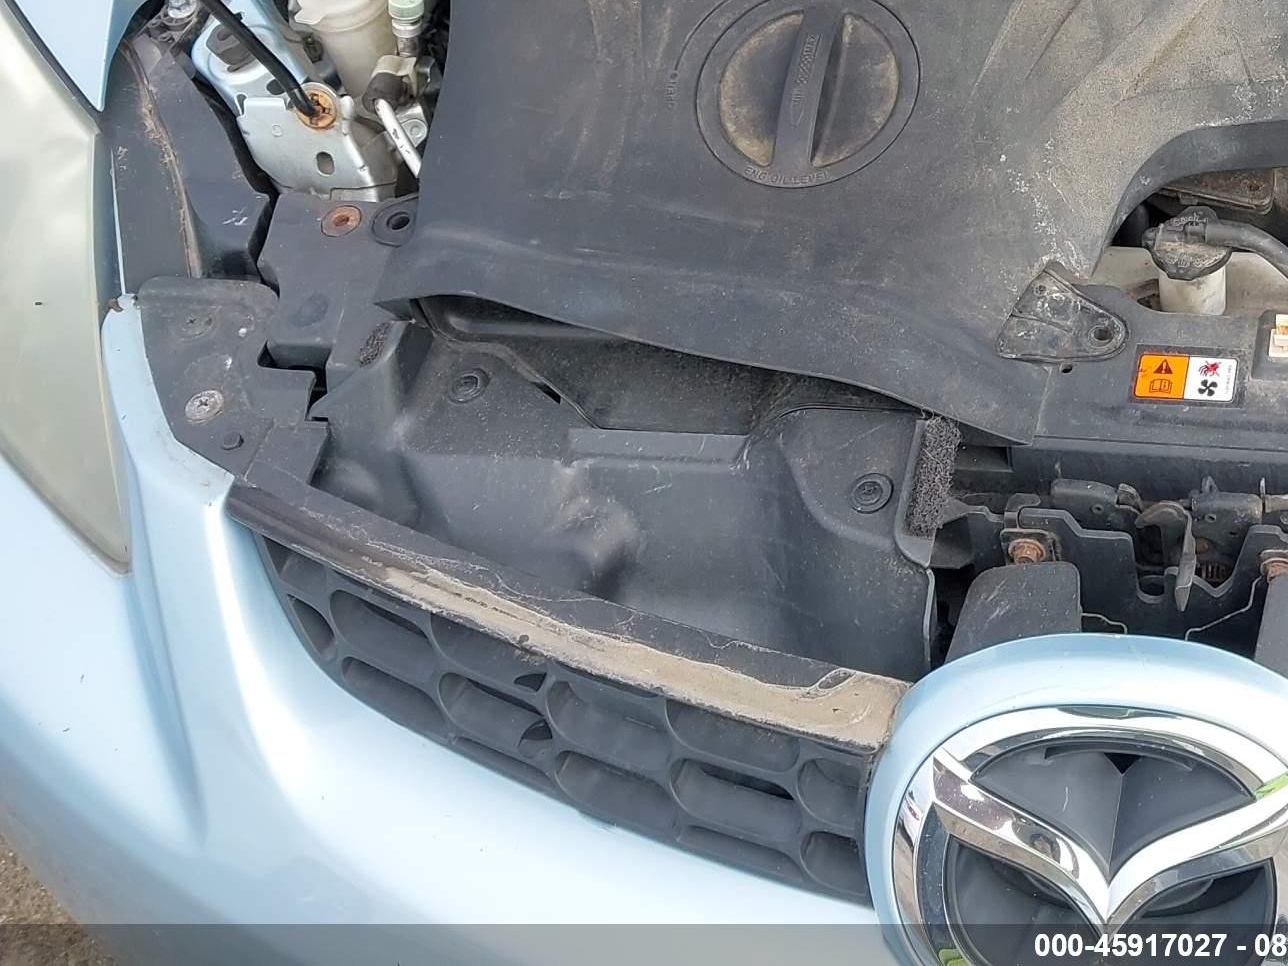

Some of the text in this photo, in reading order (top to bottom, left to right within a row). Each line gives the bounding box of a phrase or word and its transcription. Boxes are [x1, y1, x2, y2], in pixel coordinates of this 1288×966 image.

[665, 81, 678, 111] OPEN
[744, 165, 769, 181] ENG
[770, 173, 791, 185] OIL
